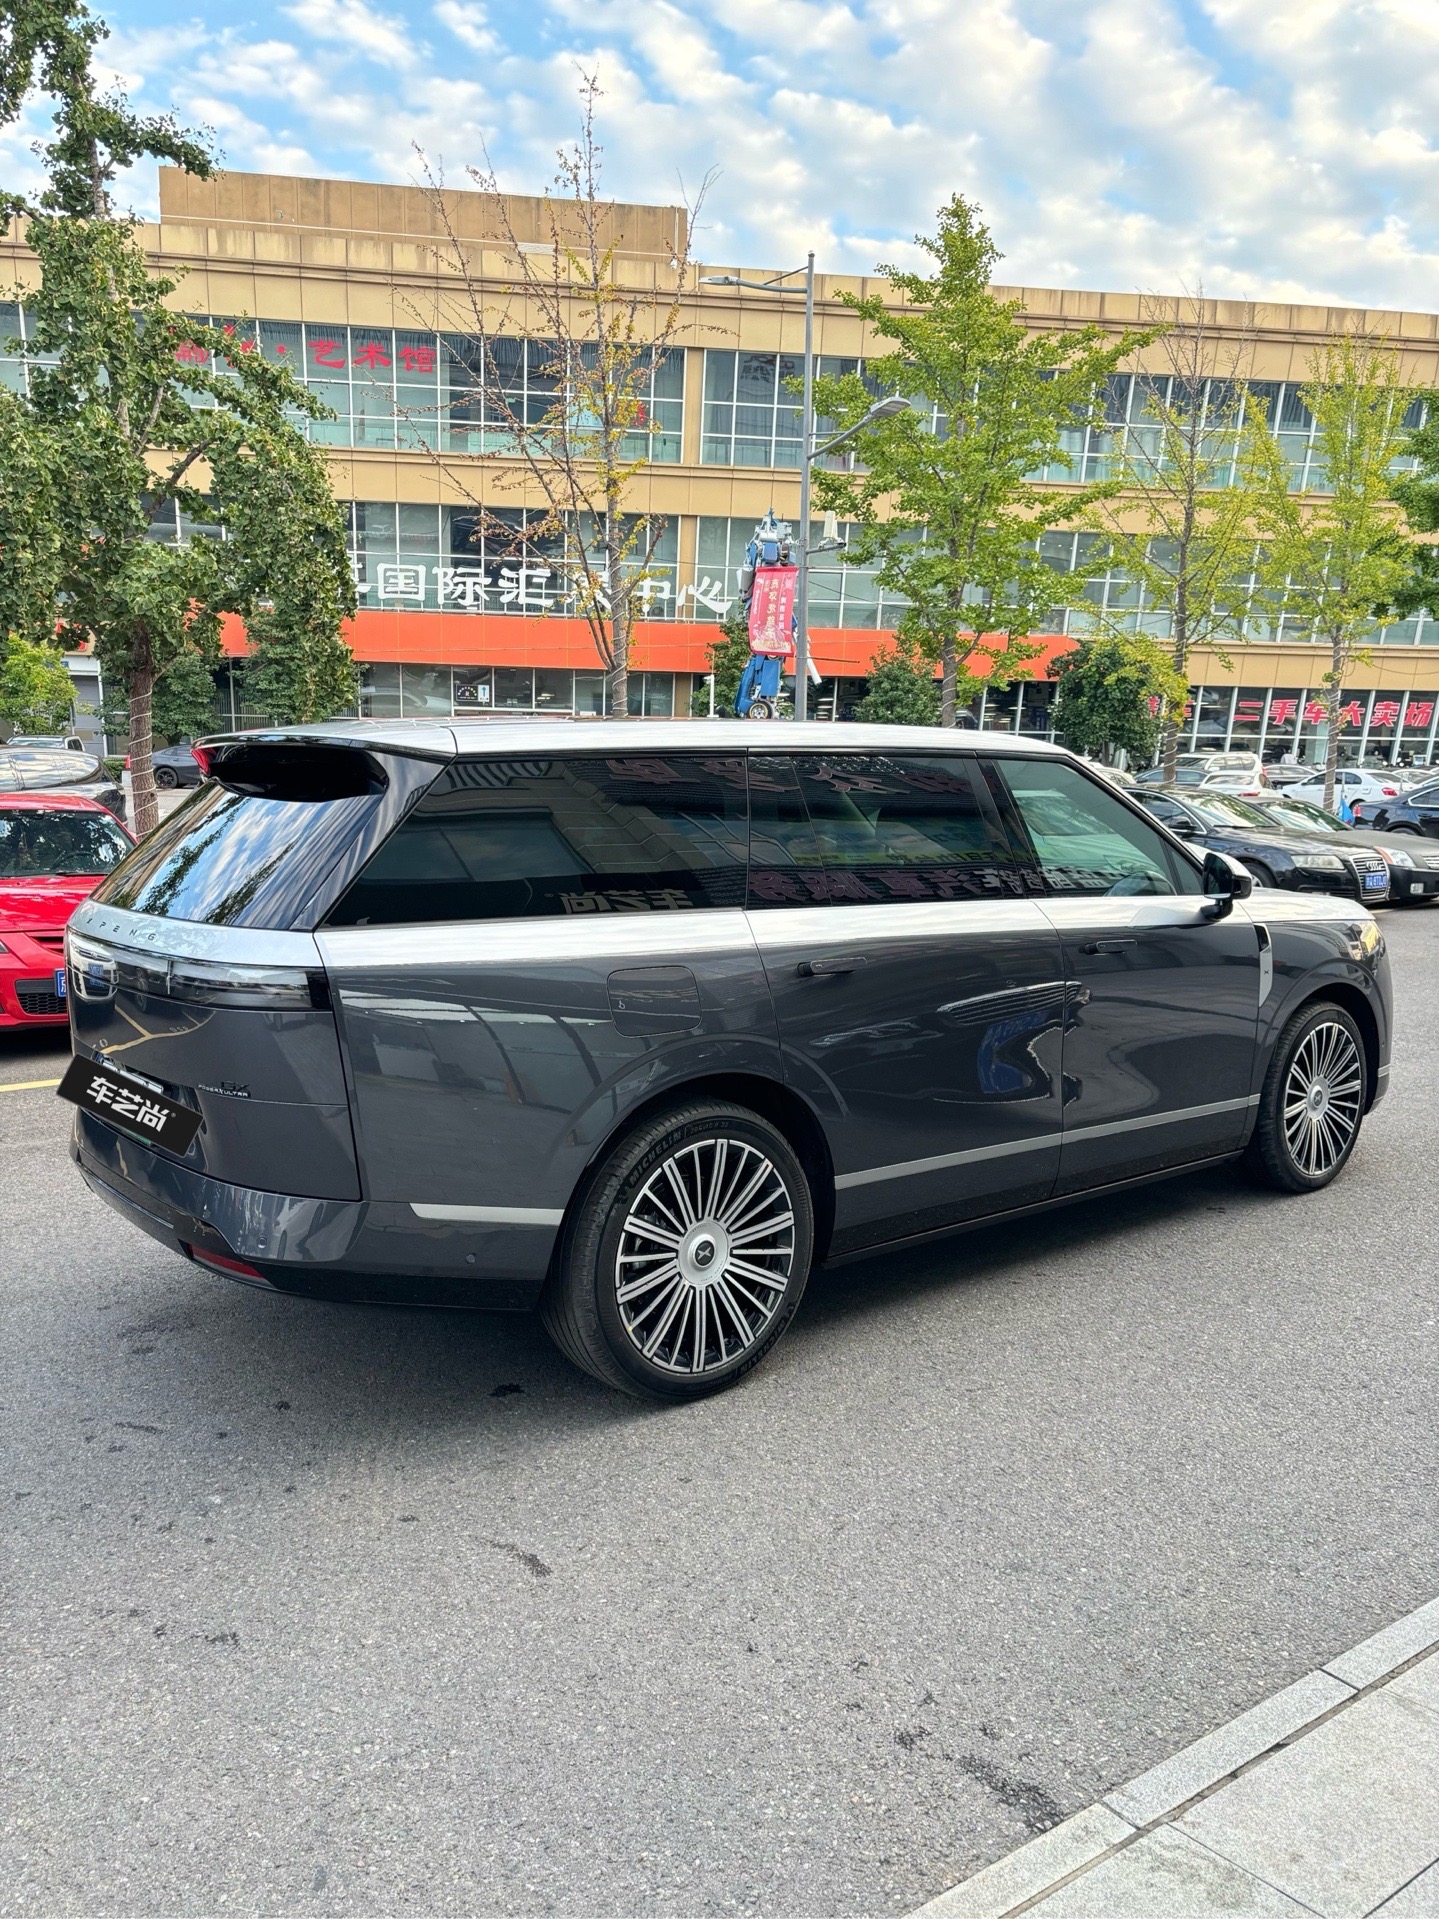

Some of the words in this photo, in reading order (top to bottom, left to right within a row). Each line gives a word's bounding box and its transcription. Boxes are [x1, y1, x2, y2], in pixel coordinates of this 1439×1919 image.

[1232, 698, 1436, 728] 二手车大卖场
[86, 917, 156, 942] XPENG
[629, 1129, 683, 1186] MICHELIN
